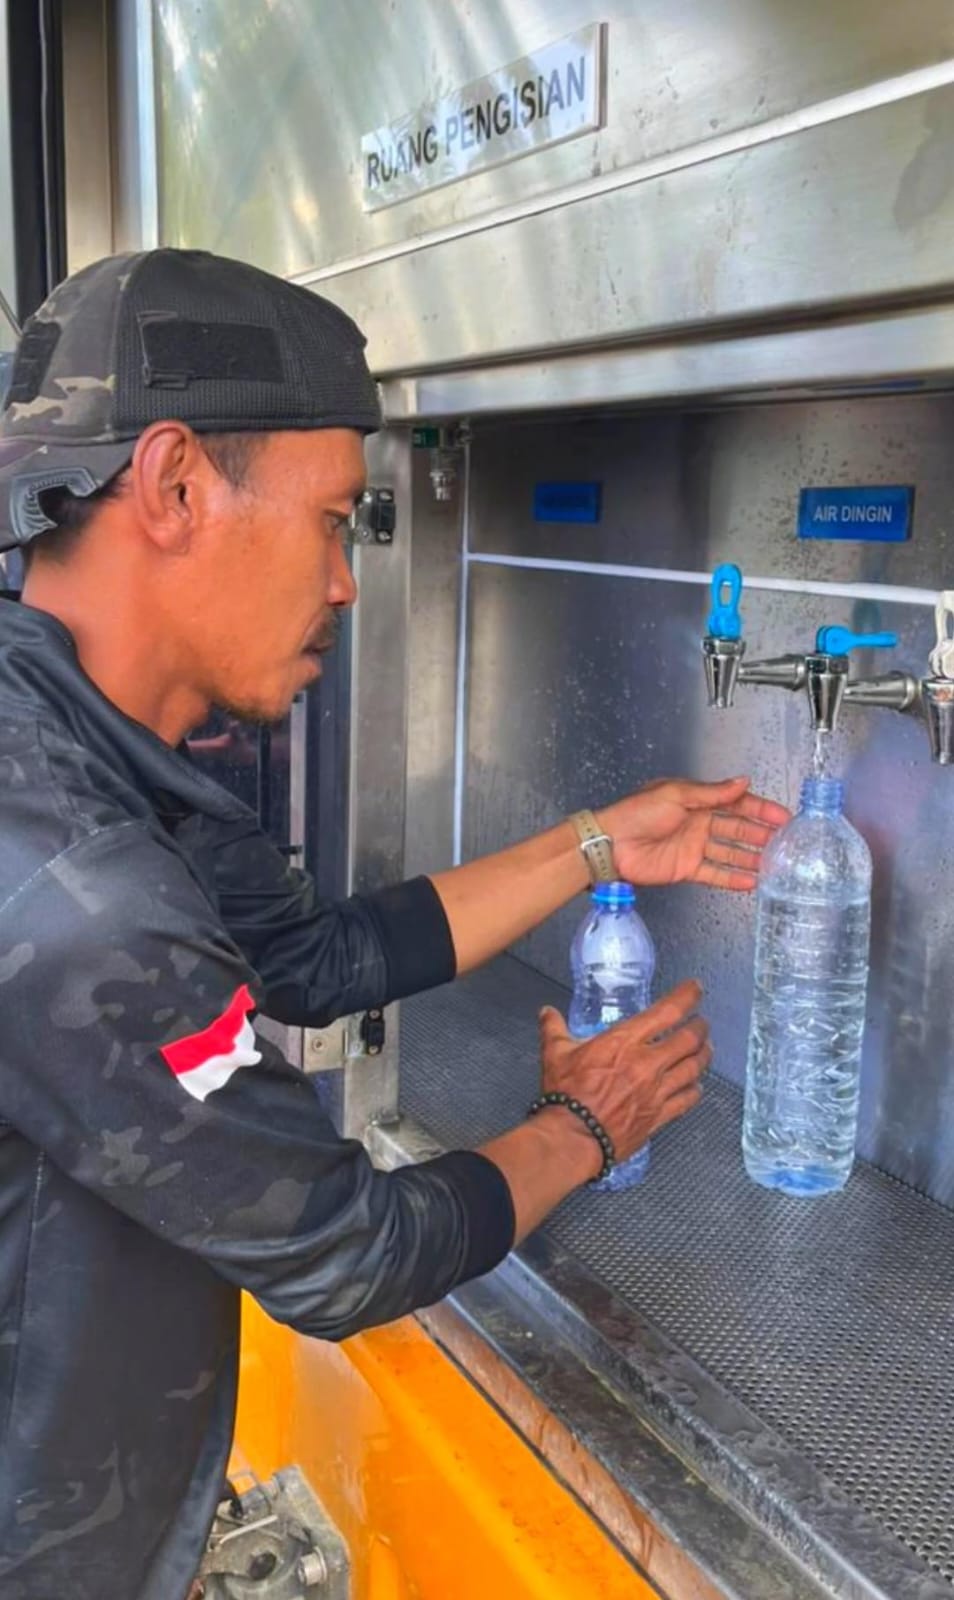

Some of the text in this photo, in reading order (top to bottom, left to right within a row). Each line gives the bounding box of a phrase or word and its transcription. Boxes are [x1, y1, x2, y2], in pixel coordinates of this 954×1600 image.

[367, 56, 585, 188] RUANG PENGISIAN
[813, 505, 893, 522] AIR DINGIN
